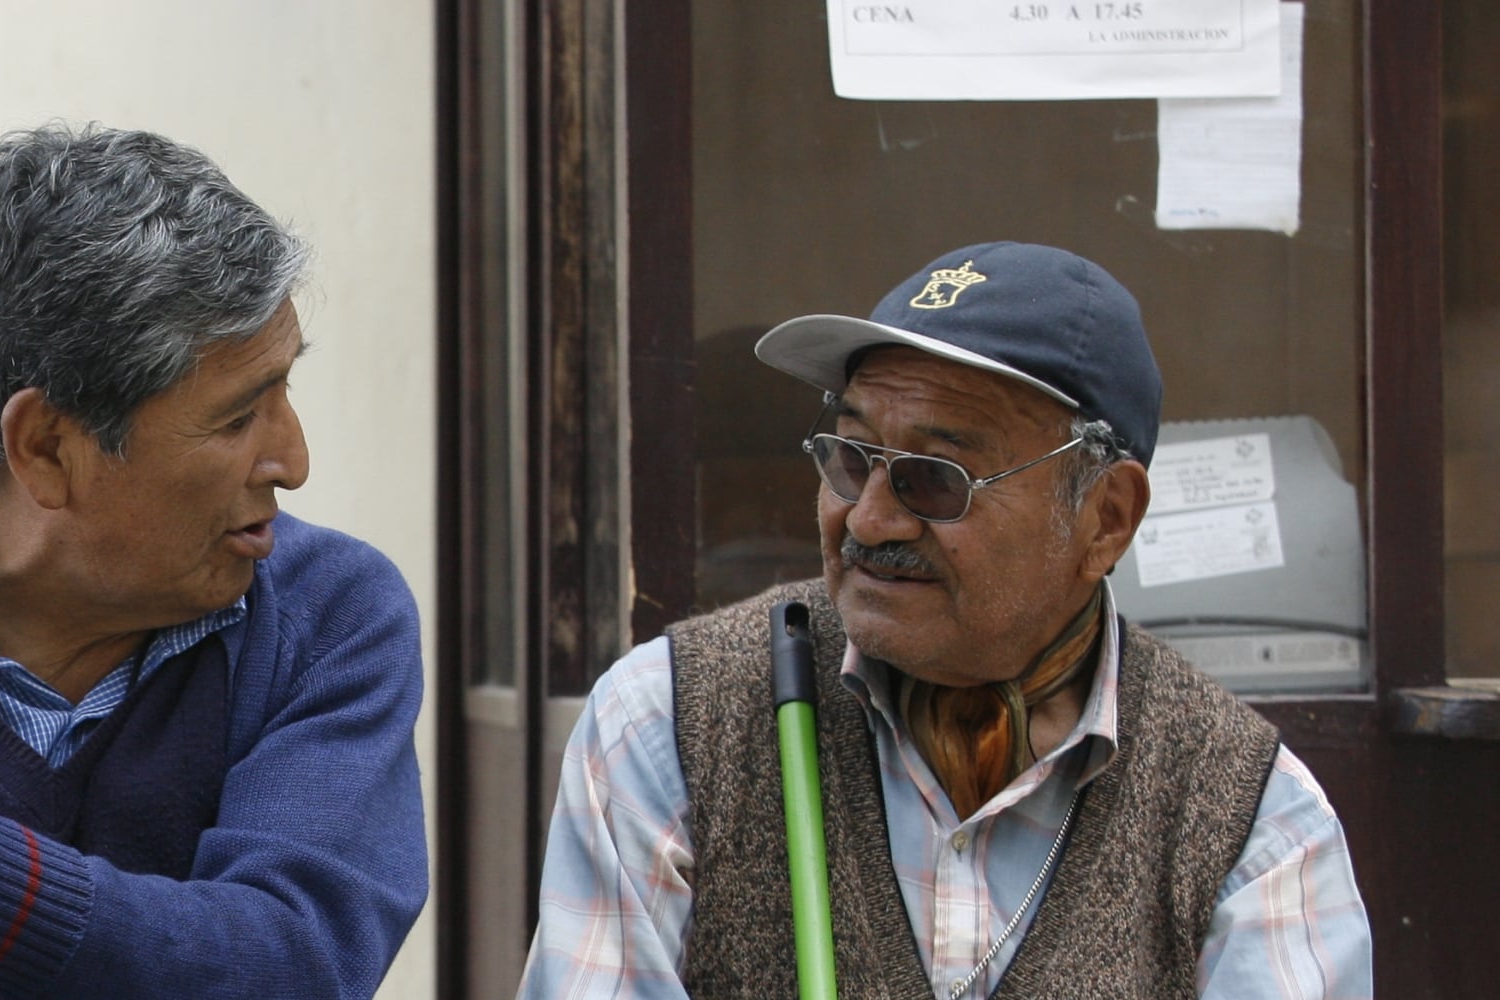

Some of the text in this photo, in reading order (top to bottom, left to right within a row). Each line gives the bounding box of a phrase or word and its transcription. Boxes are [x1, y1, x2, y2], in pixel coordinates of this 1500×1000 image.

[853, 5, 915, 23] CENA
[1067, 5, 1080, 21] A
[1094, 3, 1143, 20] 17.45
[1088, 28, 1229, 42] LA ADMINISTRACION
